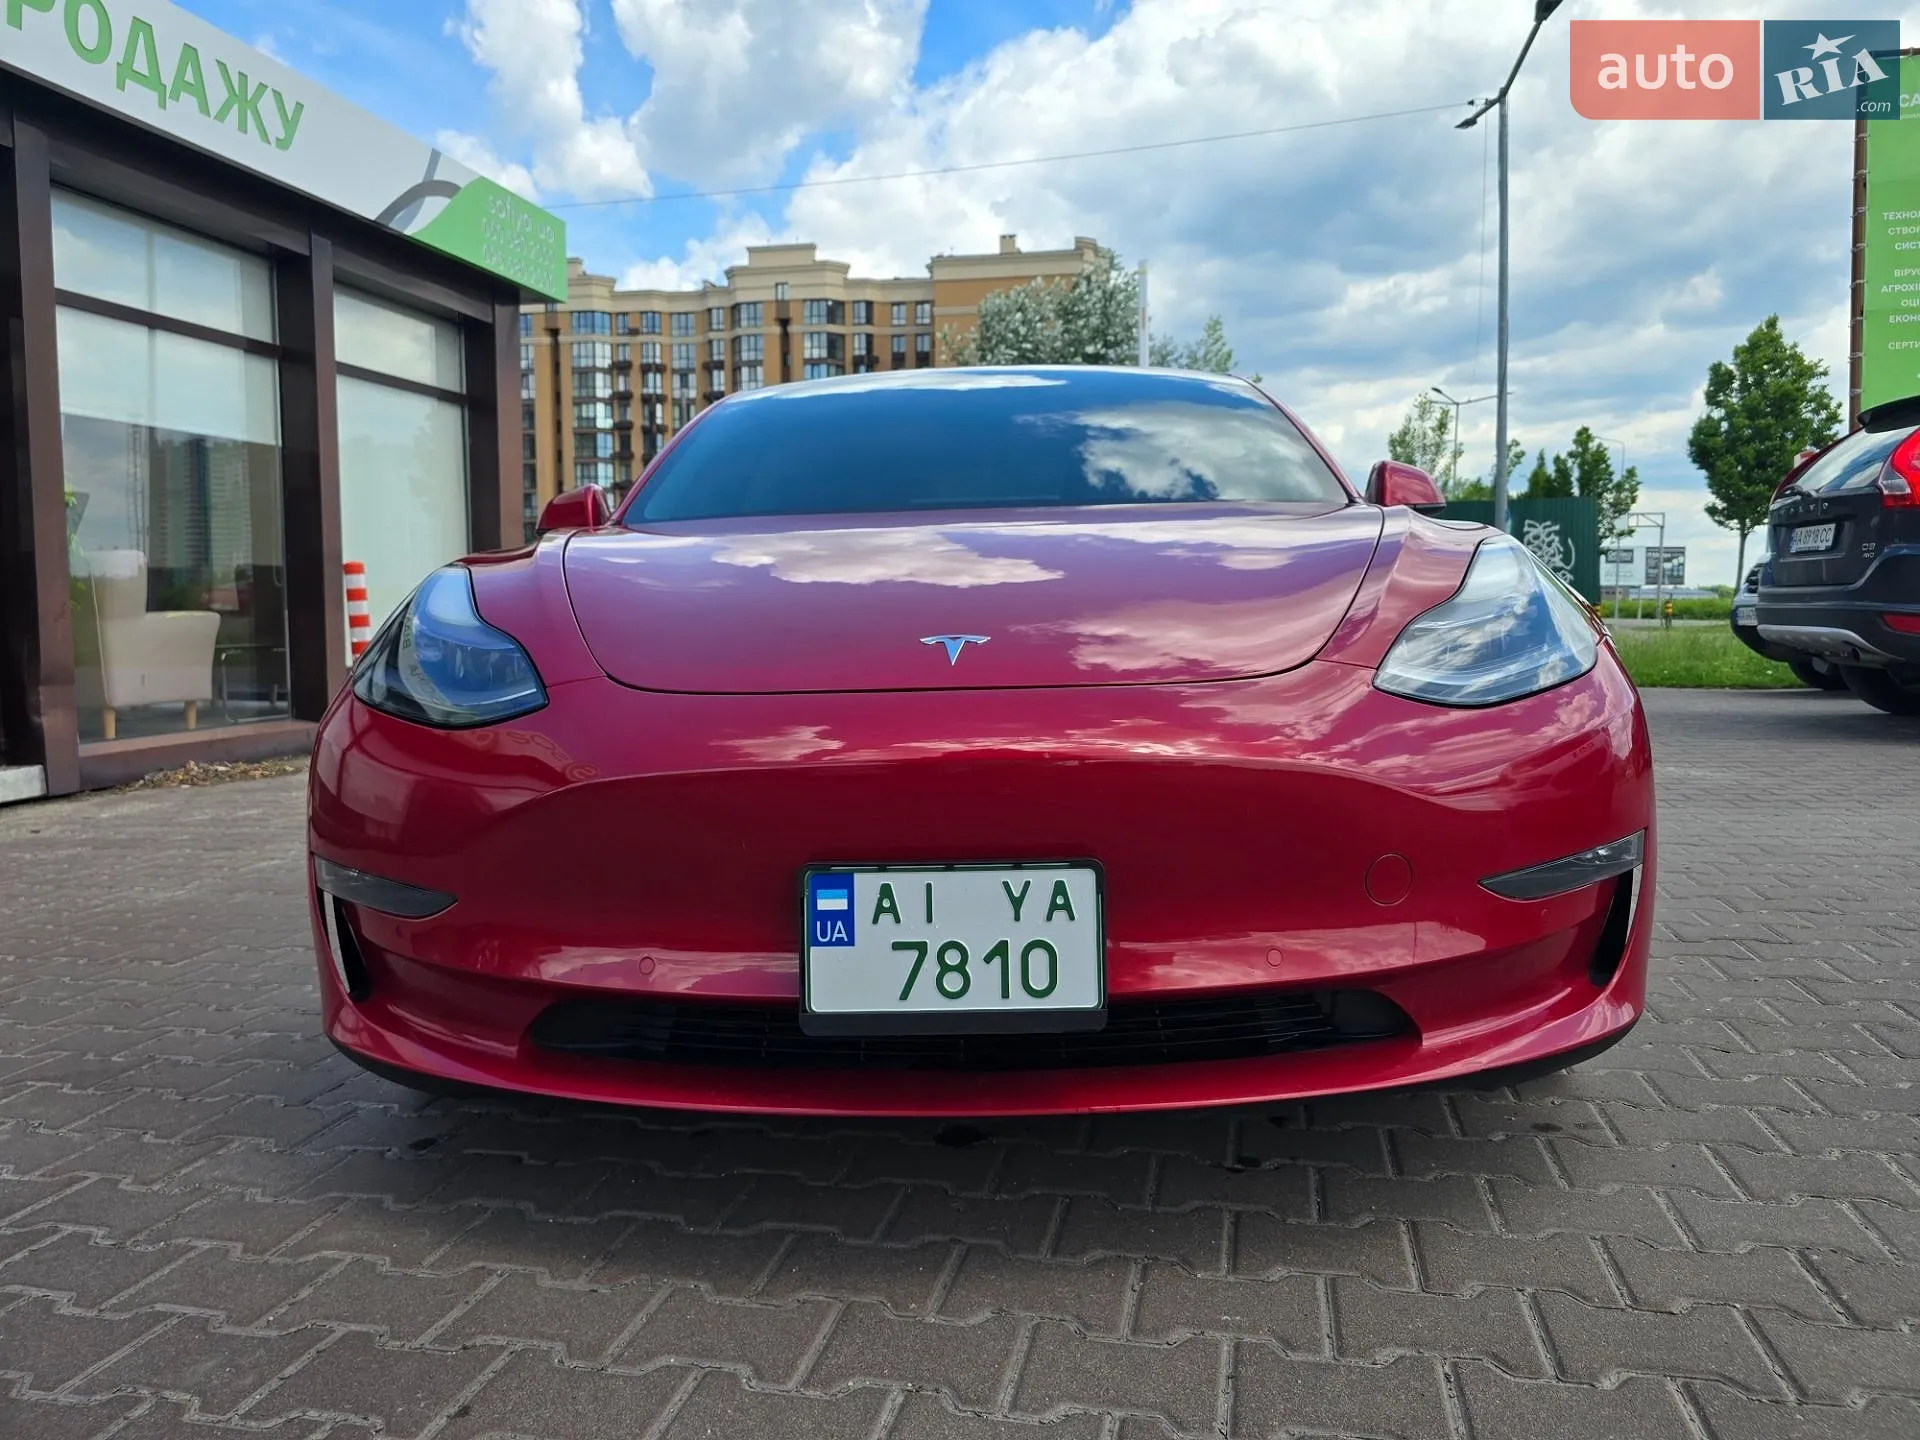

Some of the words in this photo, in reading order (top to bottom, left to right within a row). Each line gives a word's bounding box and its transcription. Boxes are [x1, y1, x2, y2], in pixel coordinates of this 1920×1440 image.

[1881, 284, 1920, 293] АГРОХІ
[872, 881, 933, 925] AI
[1002, 880, 1076, 921] YA
[817, 921, 848, 942] UA
[891, 939, 1058, 1000] 7810
